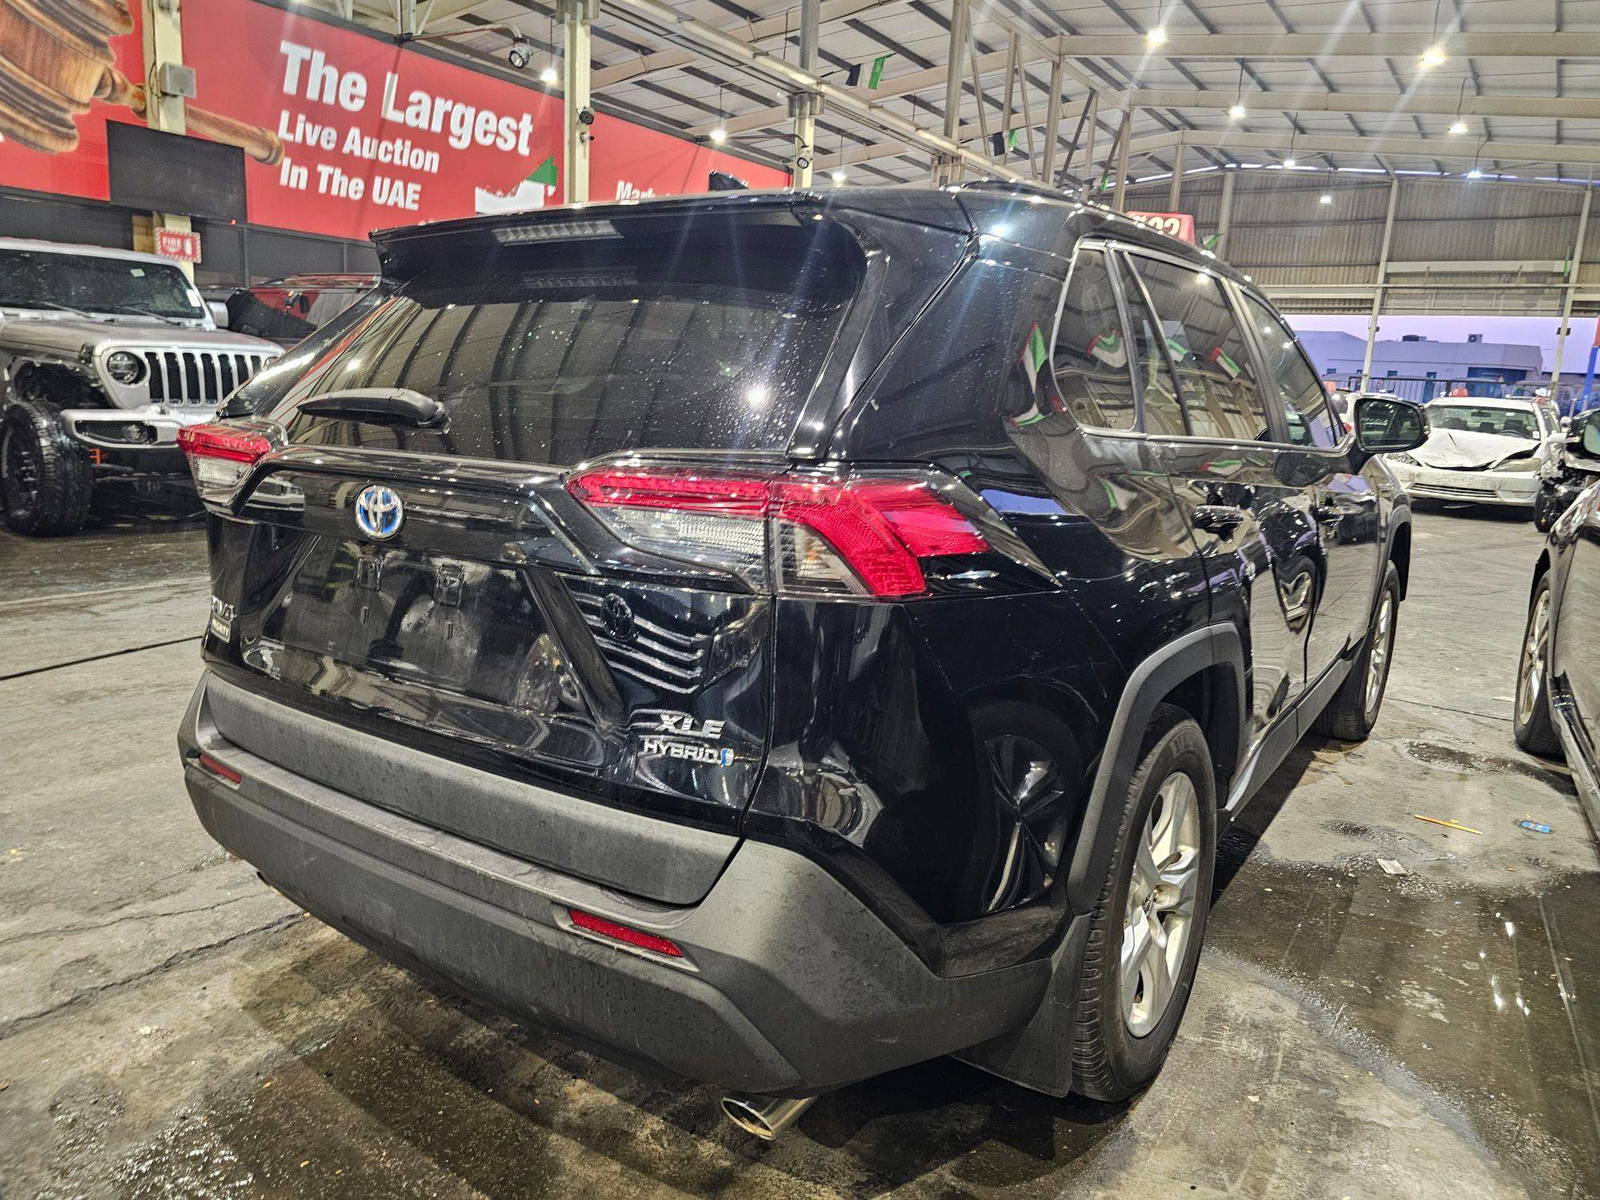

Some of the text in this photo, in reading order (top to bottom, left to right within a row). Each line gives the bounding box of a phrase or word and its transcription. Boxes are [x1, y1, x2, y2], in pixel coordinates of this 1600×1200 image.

[280, 40, 533, 156] The Largest
[278, 109, 440, 174] Live Auction
[279, 157, 422, 211] In The UAE
[643, 737, 720, 764] HYBRID
[655, 713, 727, 739] XLE
